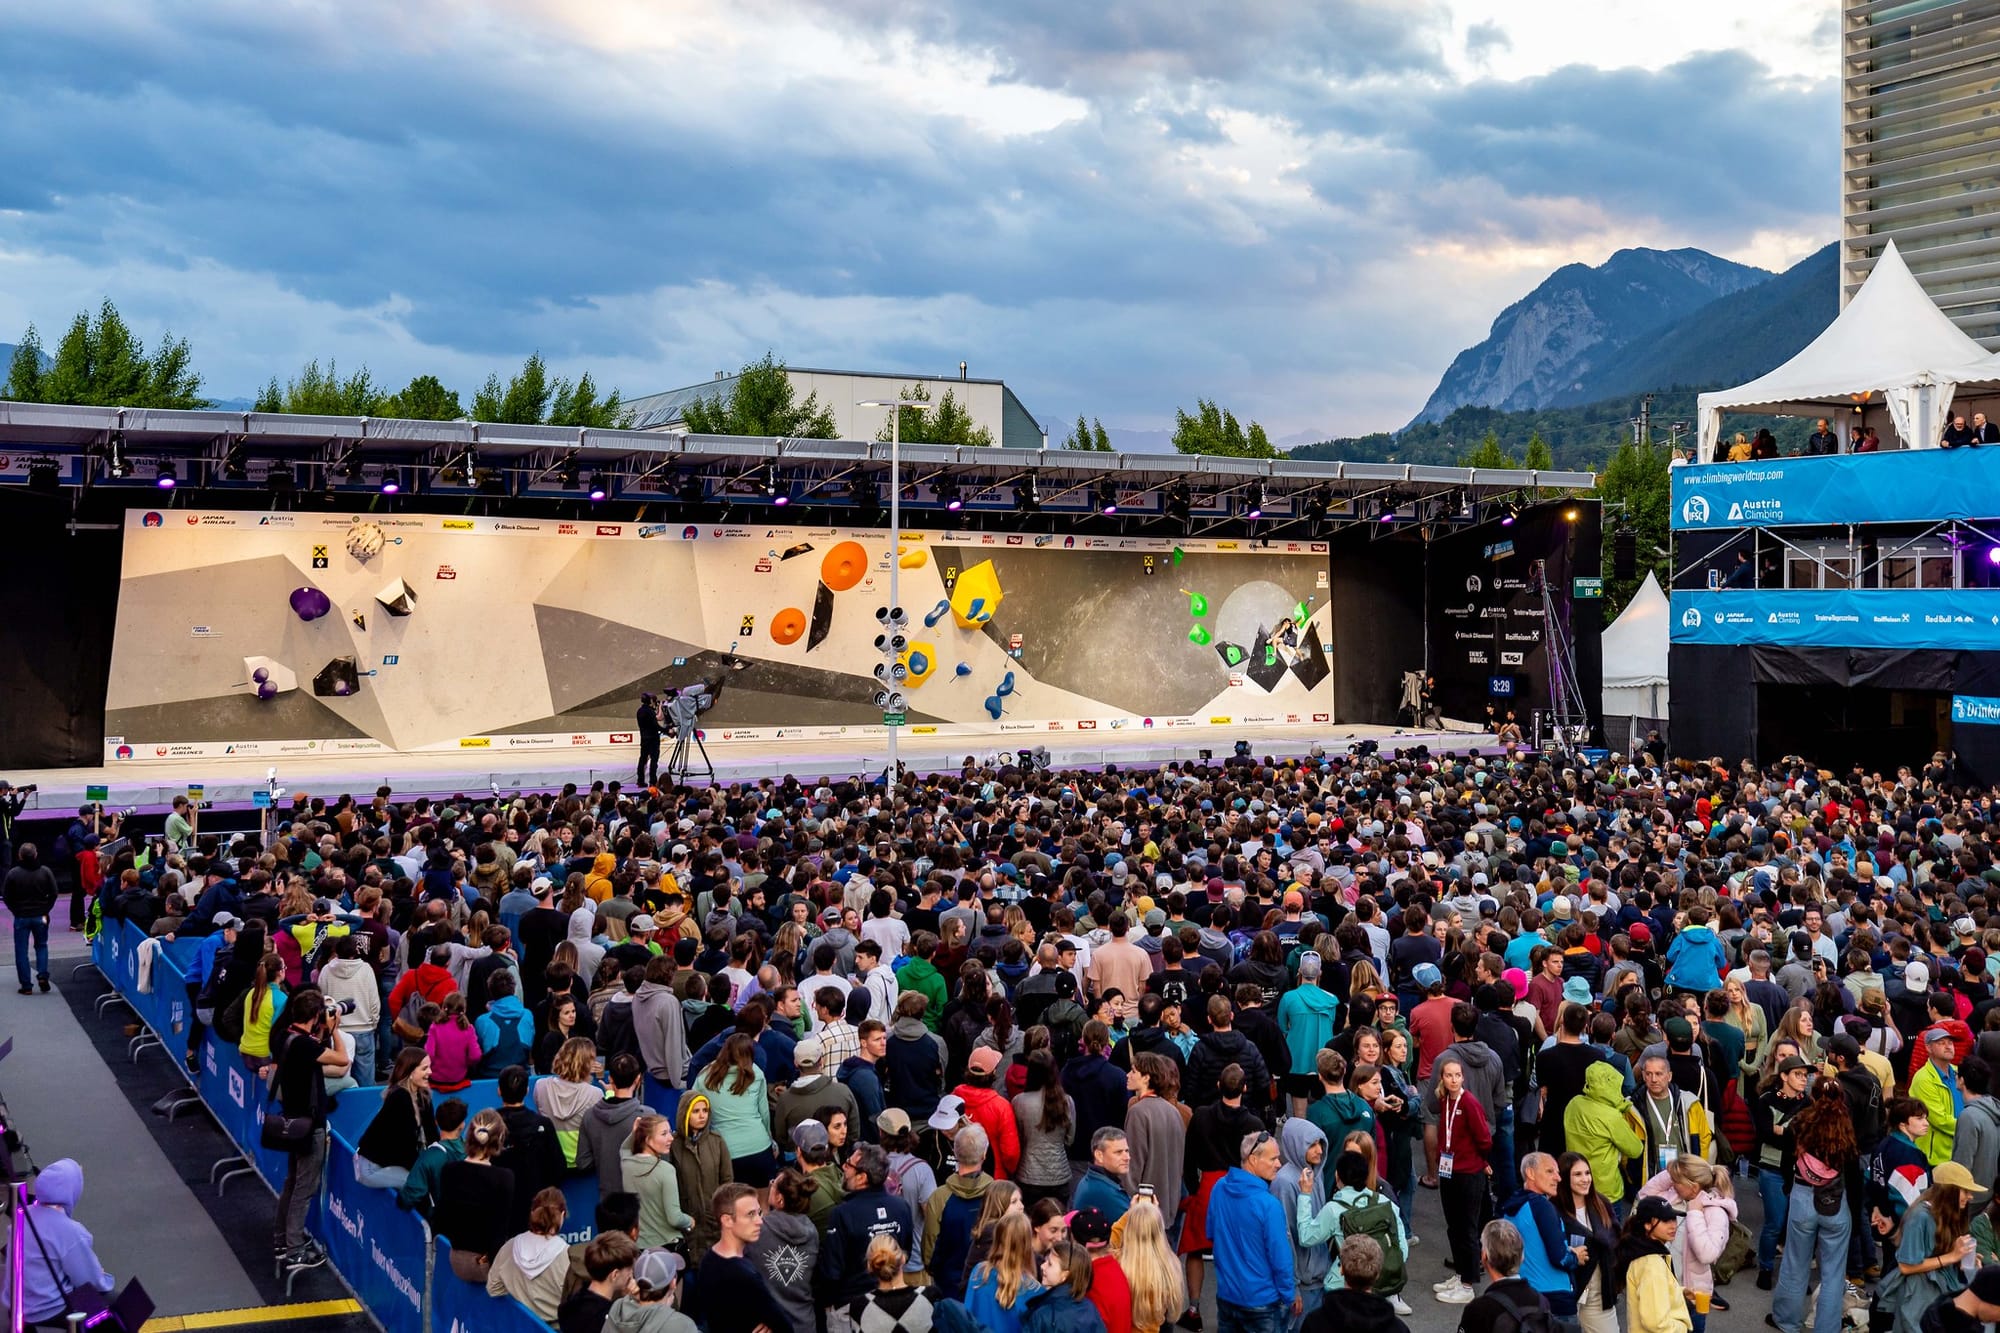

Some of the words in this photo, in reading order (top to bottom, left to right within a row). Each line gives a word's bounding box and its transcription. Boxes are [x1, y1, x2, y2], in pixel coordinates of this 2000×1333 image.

[1684, 470, 1784, 485] www.climbingworldcup.com
[1742, 499, 1780, 509] Austria
[1688, 512, 1703, 520] IFSC
[1744, 510, 1783, 520] Climbing
[1493, 680, 1510, 692] 3:29
